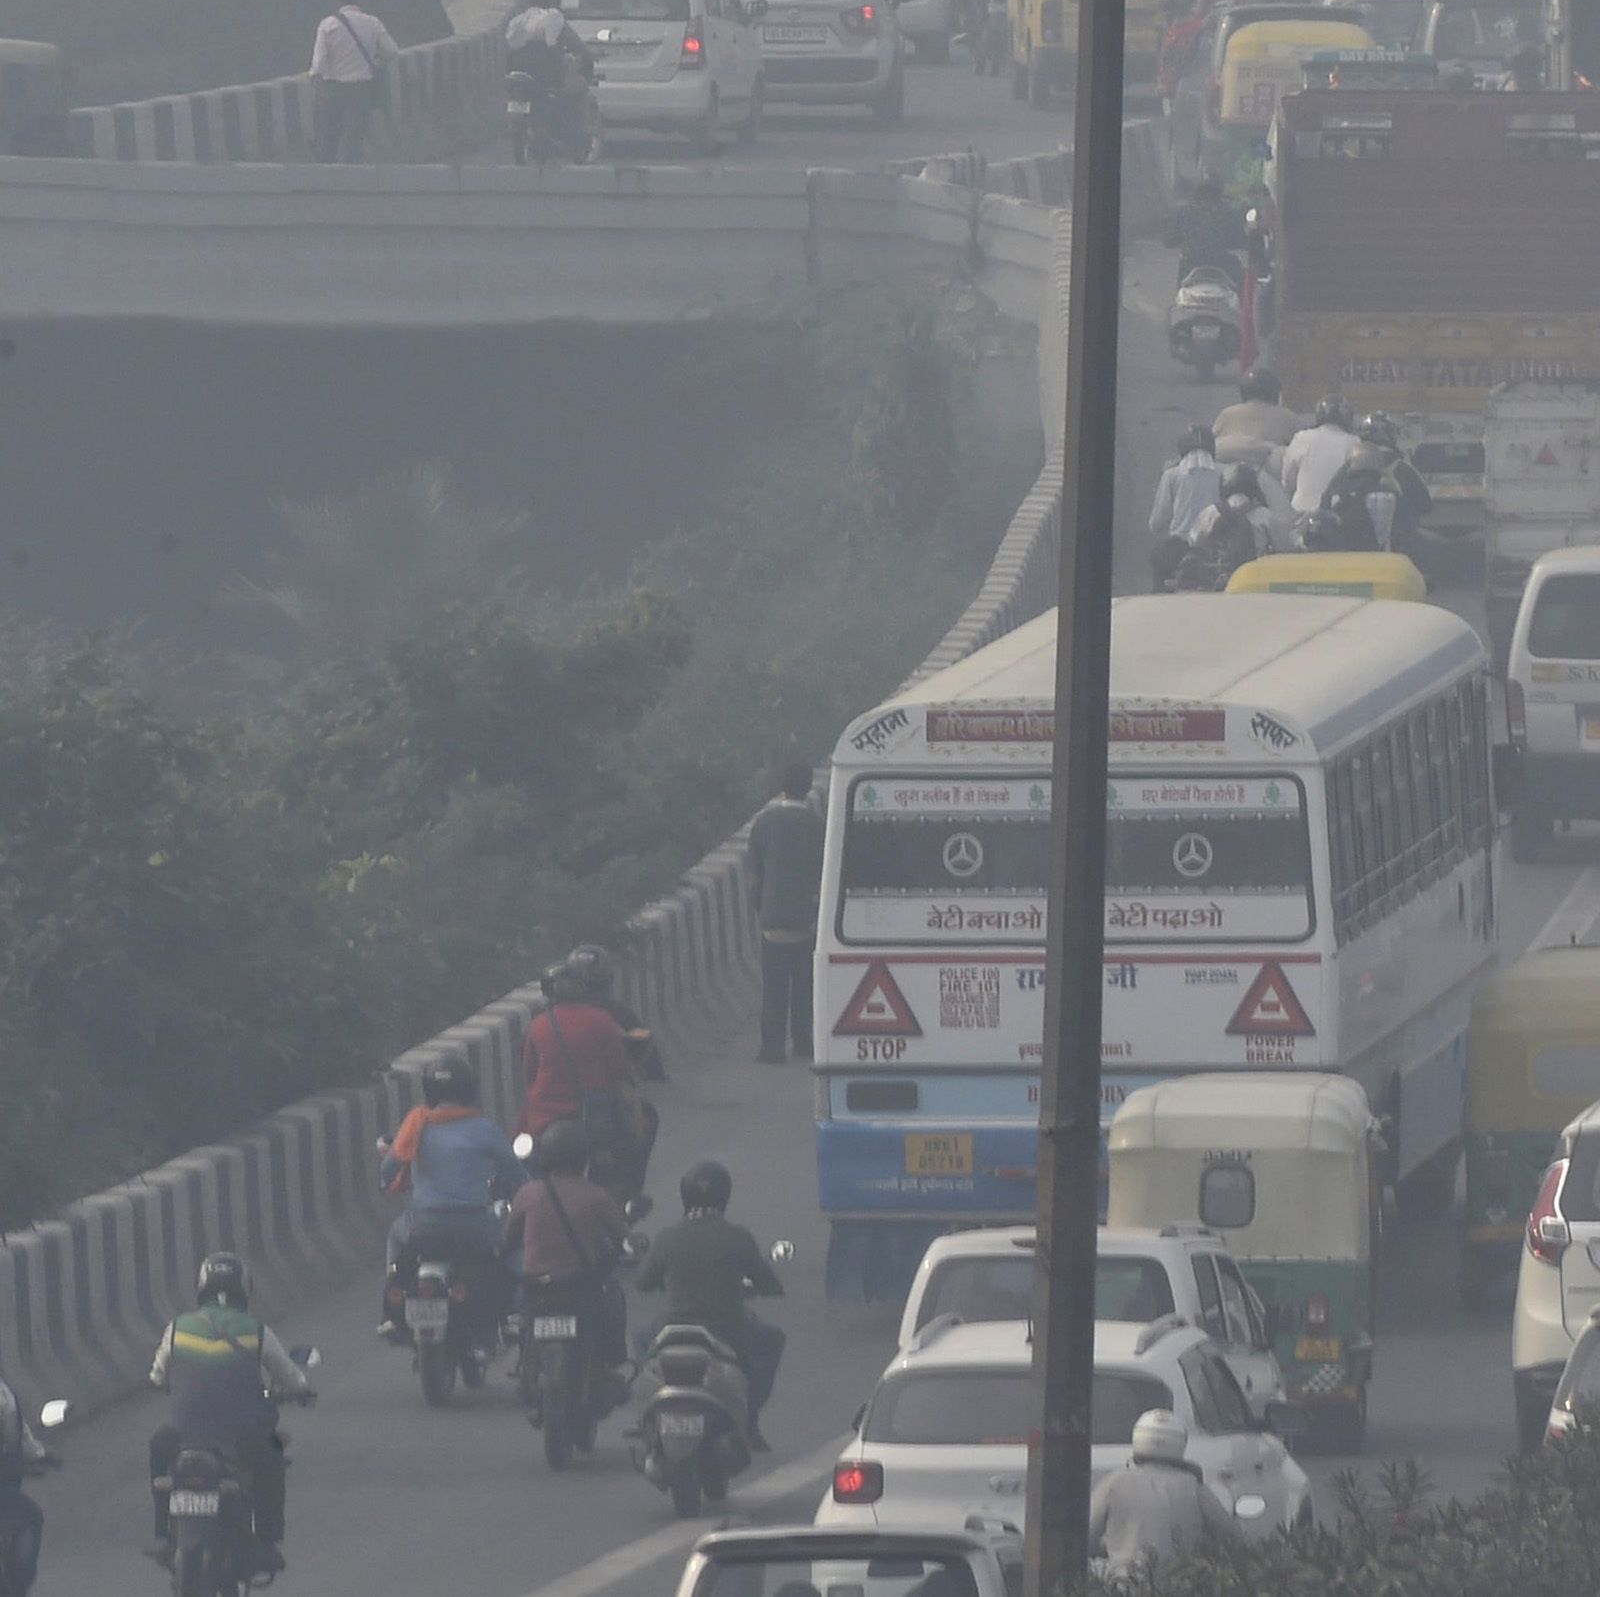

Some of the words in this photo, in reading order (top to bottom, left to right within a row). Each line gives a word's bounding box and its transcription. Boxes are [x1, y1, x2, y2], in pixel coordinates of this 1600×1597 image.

[851, 708, 909, 751] सुहाना
[927, 905, 963, 930] बेटी
[1109, 902, 1148, 929] बेटी
[939, 967, 978, 980] POLICE
[981, 967, 1000, 980] 100
[939, 981, 971, 992] FIRE
[978, 981, 1000, 992] 101
[1245, 1035, 1295, 1047] POWER
[857, 1038, 907, 1061] STOP
[1246, 1049, 1295, 1062] BREAK
